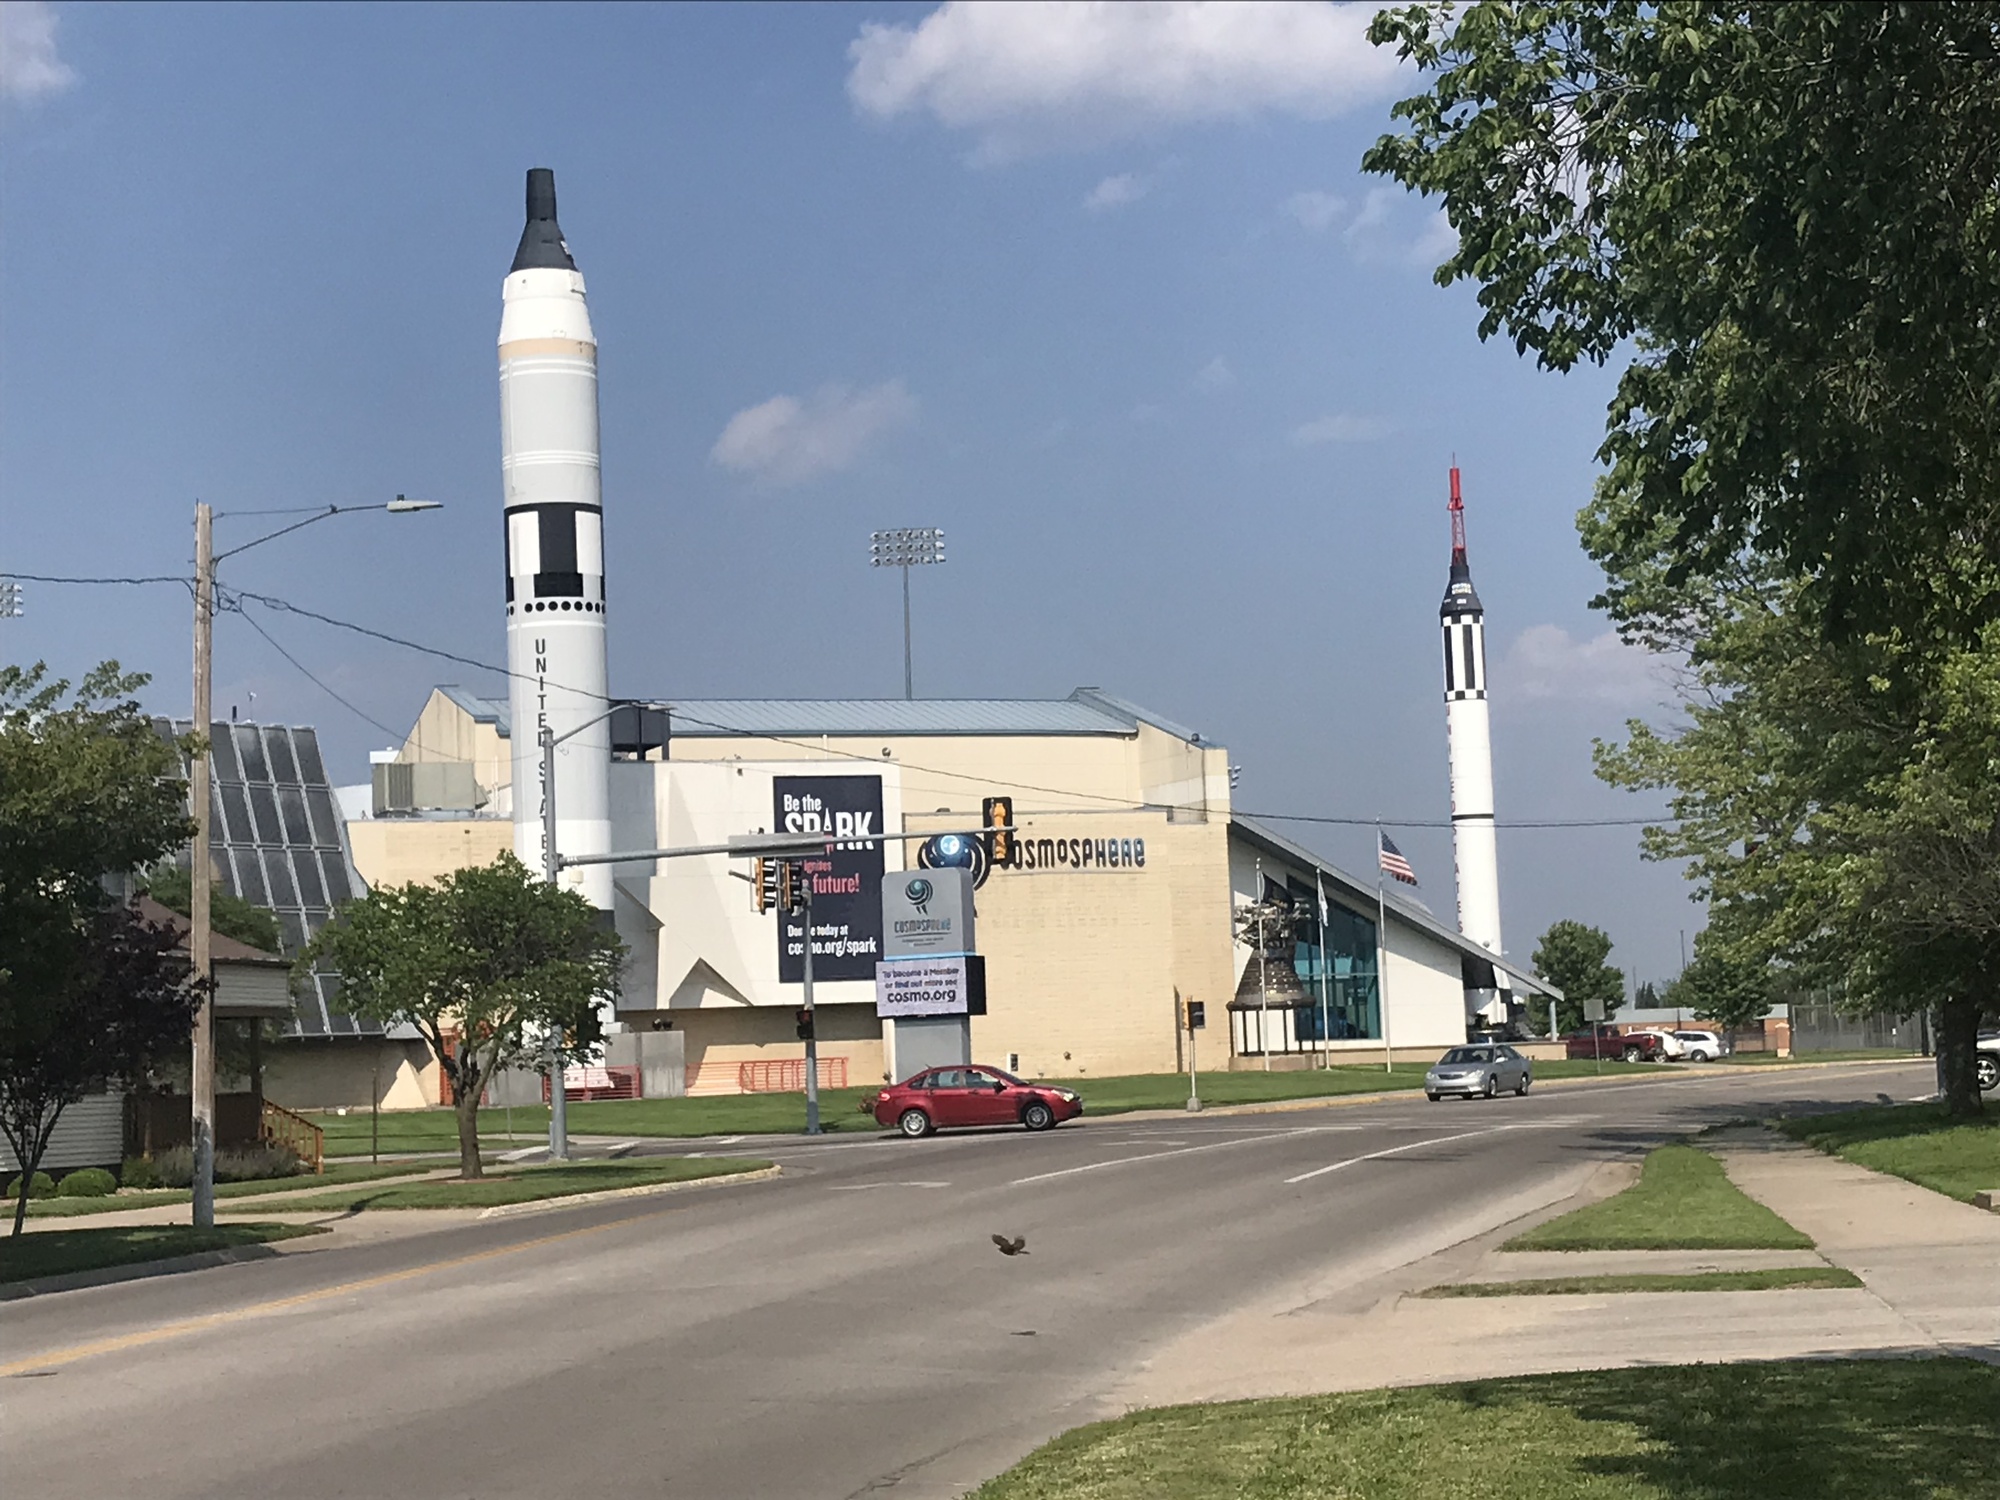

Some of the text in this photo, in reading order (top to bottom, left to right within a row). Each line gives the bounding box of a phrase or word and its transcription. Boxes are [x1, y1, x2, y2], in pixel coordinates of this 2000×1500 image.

[783, 793, 822, 812] Be the
[1001, 838, 1146, 870] OSMOSPHERE
[812, 872, 860, 894] future!
[1453, 823, 1464, 934] STATES
[787, 923, 849, 938] Done today at
[883, 970, 892, 979] To
[892, 969, 922, 978] become
[929, 967, 960, 976] Member
[895, 980, 909, 989] find
[910, 980, 922, 988] out
[924, 979, 943, 987] more
[887, 989, 957, 1003] cosmo.org
